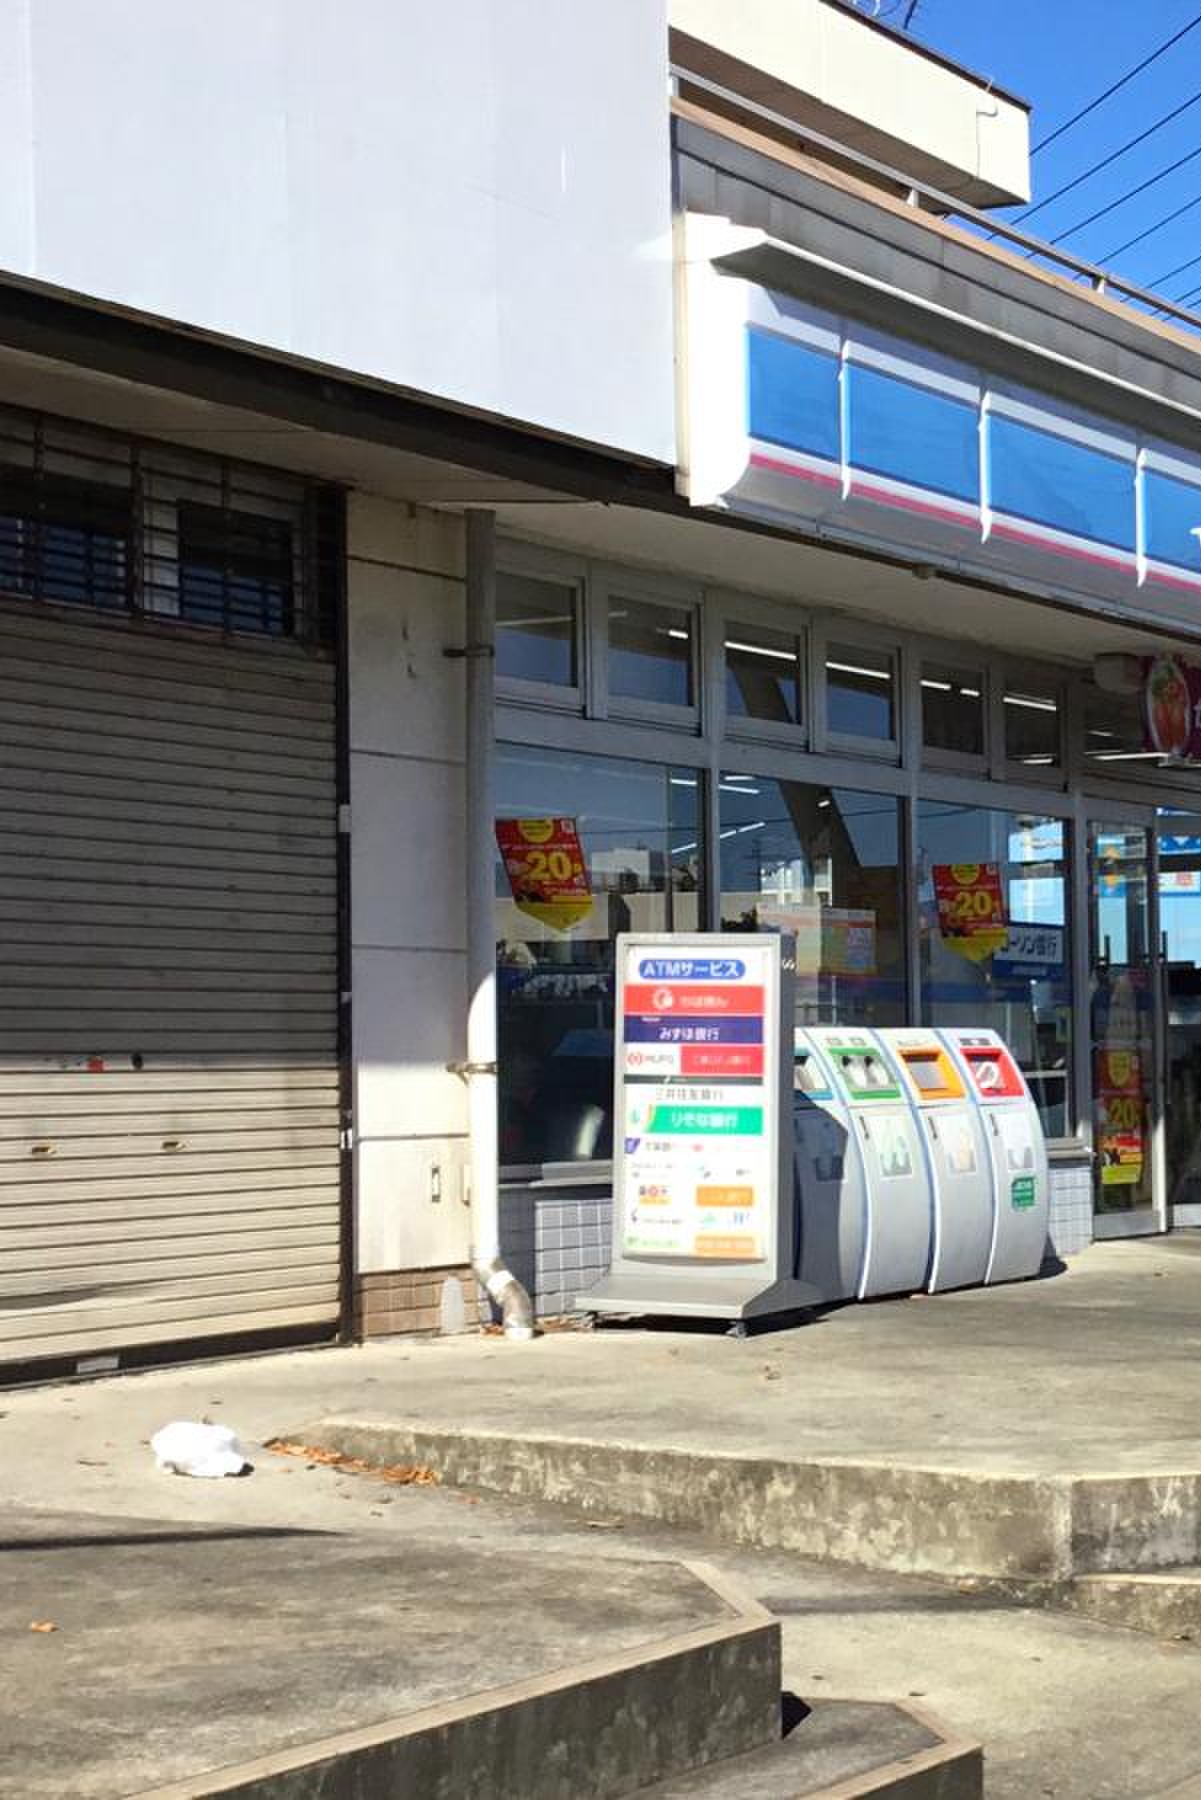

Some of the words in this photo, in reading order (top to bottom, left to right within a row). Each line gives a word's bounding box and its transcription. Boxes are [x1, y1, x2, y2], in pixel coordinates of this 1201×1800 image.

[526, 850, 572, 881] 20
[958, 890, 993, 917] 20
[1000, 933, 1057, 958] ーソン銀行
[643, 960, 739, 977] ATMサービス
[659, 1027, 719, 1041] みずほ銀行
